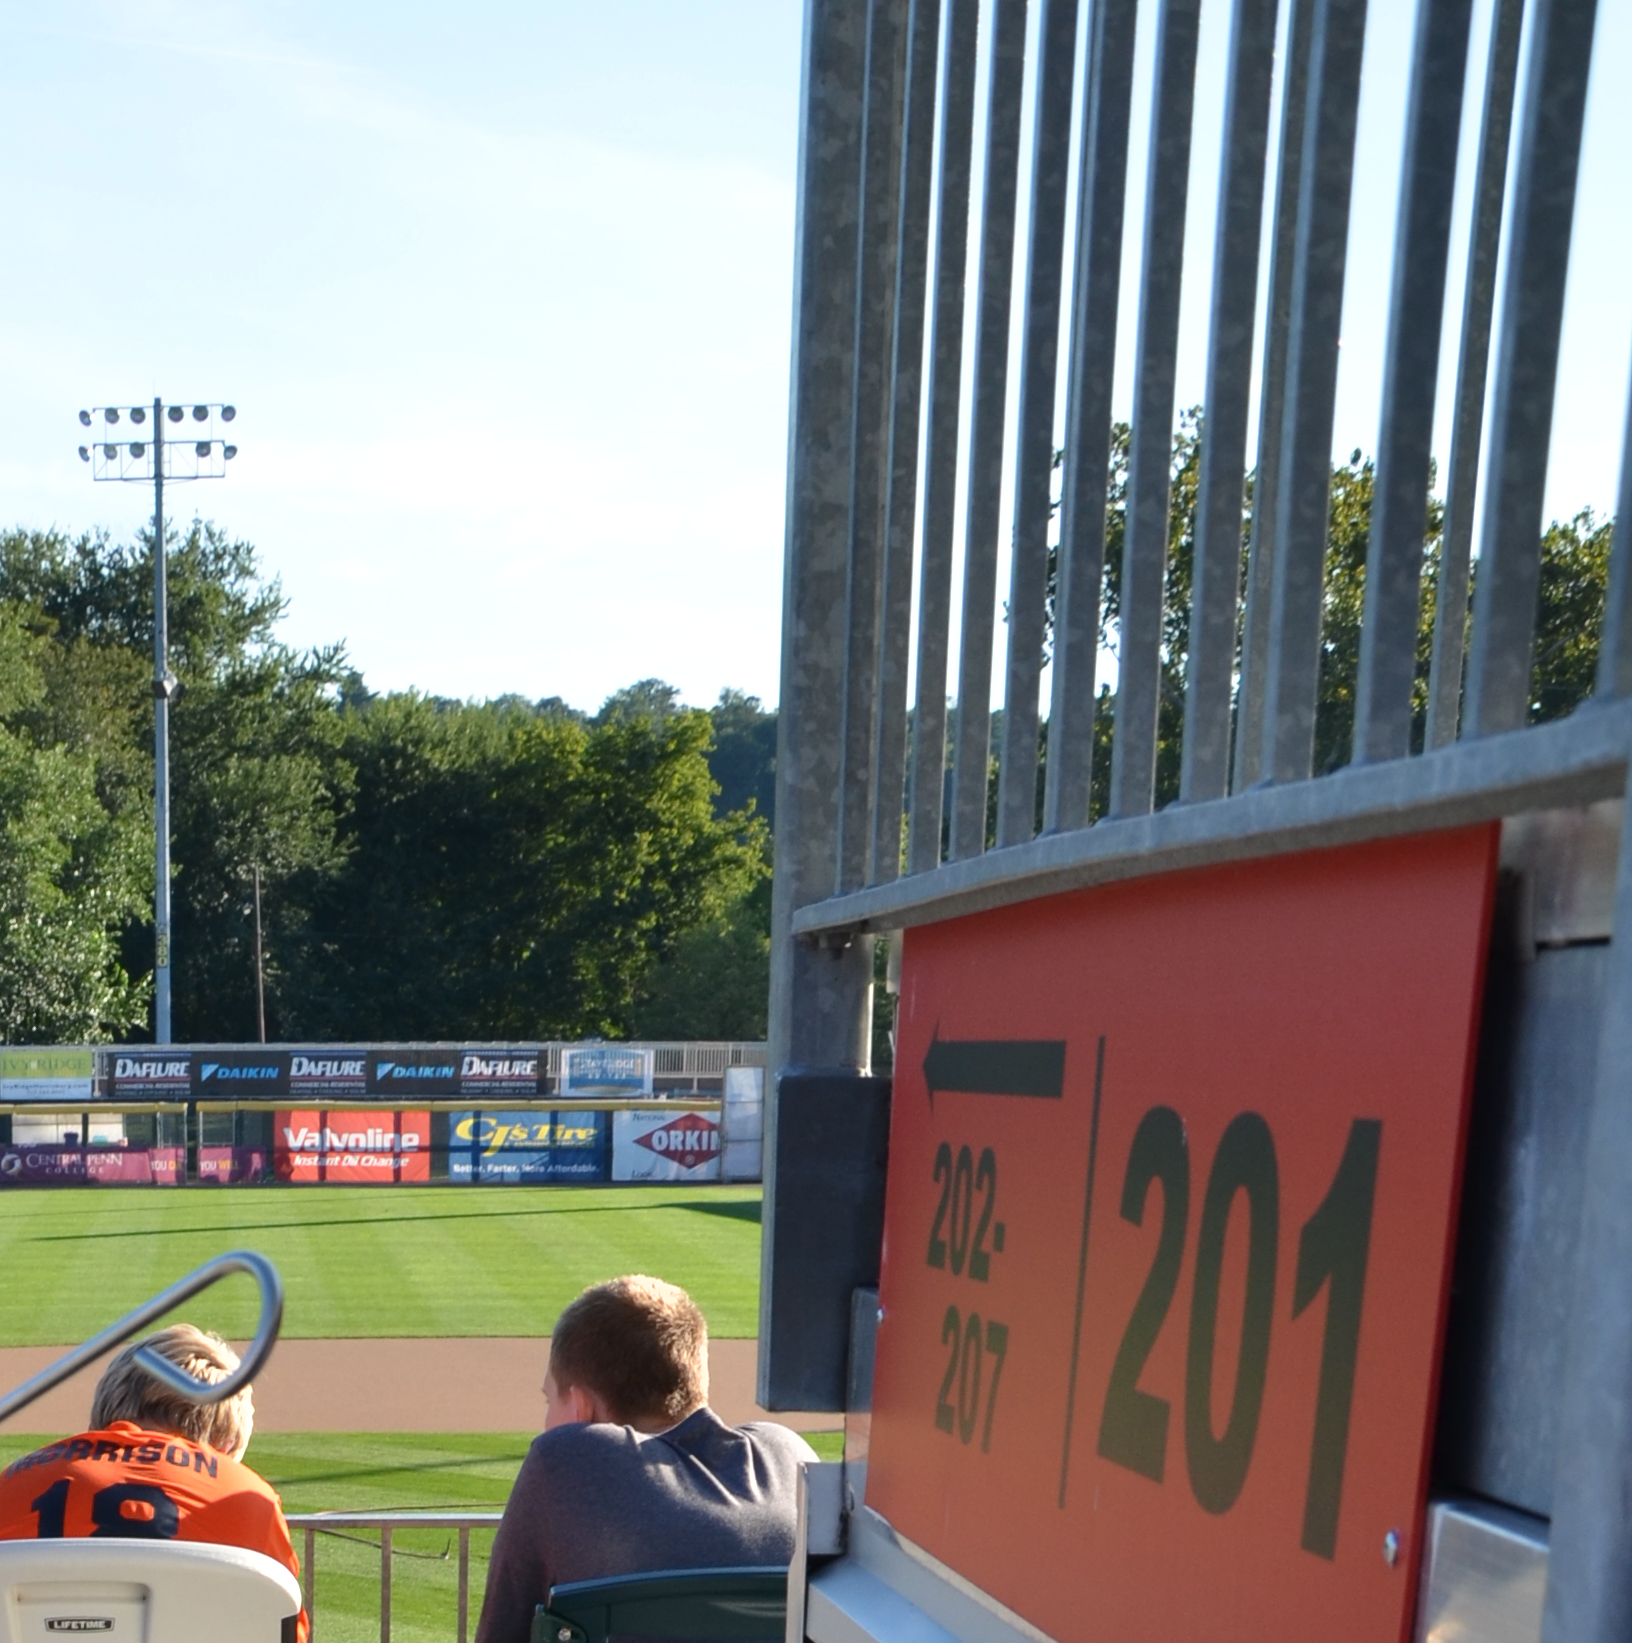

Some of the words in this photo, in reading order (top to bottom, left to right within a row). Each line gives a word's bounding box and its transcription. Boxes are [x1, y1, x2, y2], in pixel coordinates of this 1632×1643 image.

[36, 1058, 87, 1070] RIDGE
[217, 1066, 279, 1079] DAIKIN
[392, 1065, 455, 1078] DAIKIN
[283, 1127, 420, 1152] Valvoline
[455, 1117, 528, 1157] CJ's
[532, 1124, 598, 1140] Tire
[26, 1153, 82, 1168] CENTRAL
[86, 1153, 123, 1166] PENN
[200, 1160, 217, 1171] YOU
[293, 1154, 341, 1166] Instant
[341, 1154, 359, 1166] Oil
[360, 1154, 409, 1168] Change
[45, 1166, 104, 1174] COLLEGE
[1097, 1103, 1383, 1562] 201
[934, 1305, 1009, 1453] 207
[53, 1618, 107, 1630] LIFETIME
